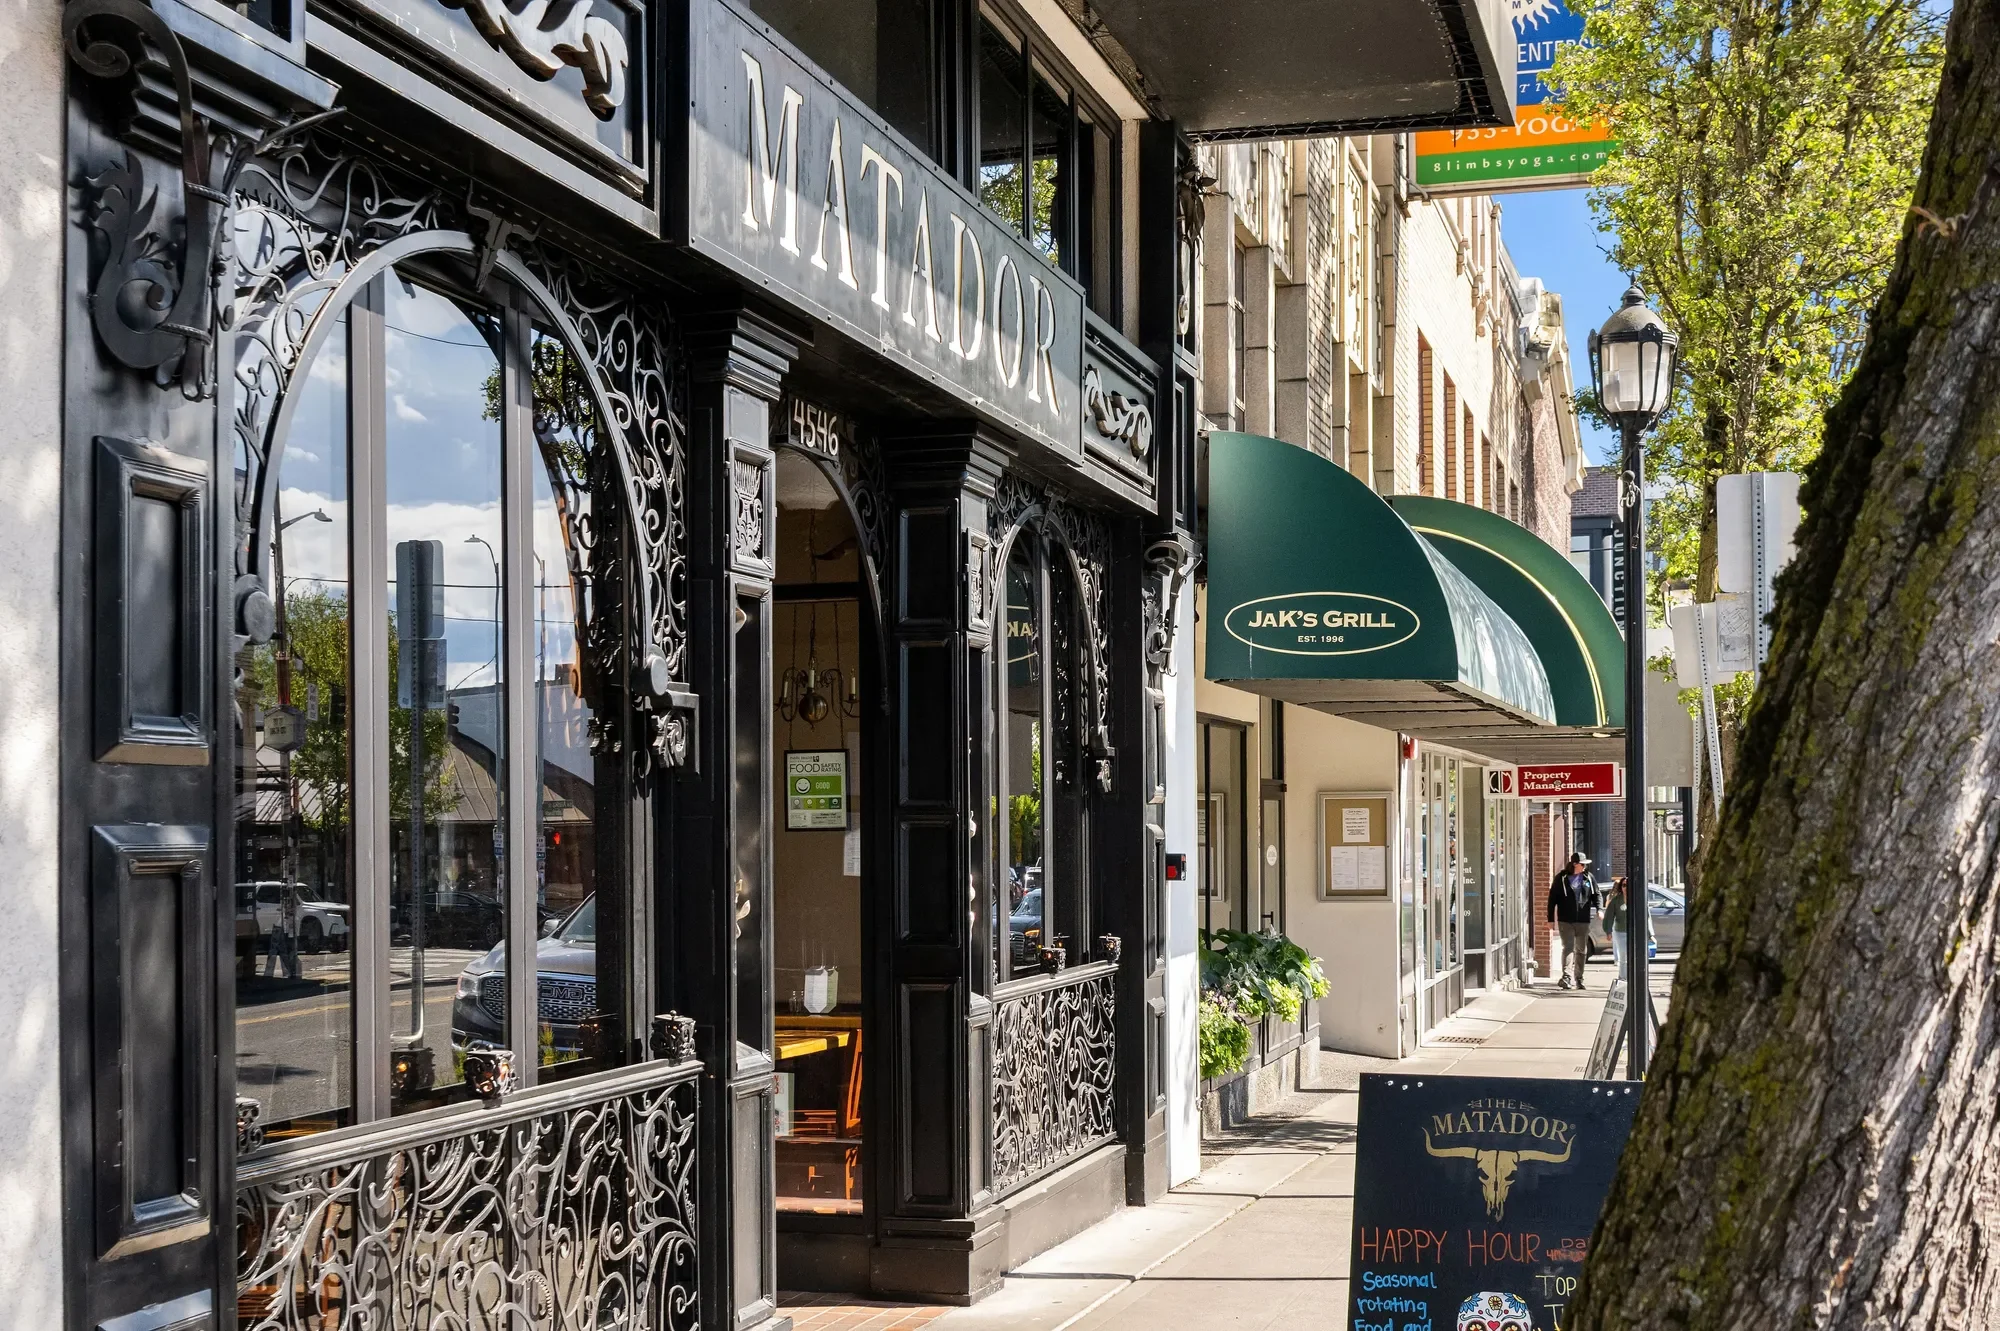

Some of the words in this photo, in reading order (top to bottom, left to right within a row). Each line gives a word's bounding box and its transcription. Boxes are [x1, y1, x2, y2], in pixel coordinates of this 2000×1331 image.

[1449, 116, 1580, 142] 933-YOG
[1433, 151, 1607, 173] 8limbsyoga.com
[741, 48, 1061, 417] MATADOR
[793, 398, 839, 456] 4546
[1613, 529, 1625, 631] JUNCTION
[1248, 610, 1318, 628] JAK'S
[1322, 610, 1396, 628] GRILL
[1297, 635, 1317, 643] EST.
[1320, 635, 1344, 643] 1996
[789, 763, 820, 773] FOOD
[1523, 771, 1572, 782] Property
[1523, 780, 1594, 792] Management
[1486, 1098, 1516, 1110] THE
[1432, 1111, 1568, 1144] MATADOR
[1360, 1226, 1448, 1264] HAPPY
[1467, 1229, 1541, 1267] HOUR
[1561, 1237, 1590, 1249] Da
[1362, 1271, 1438, 1291] Seasonal
[1535, 1275, 1577, 1297] TOP
[1357, 1297, 1428, 1320] rotating
[1354, 1318, 1393, 1331] Food
[1402, 1318, 1432, 1331] and
